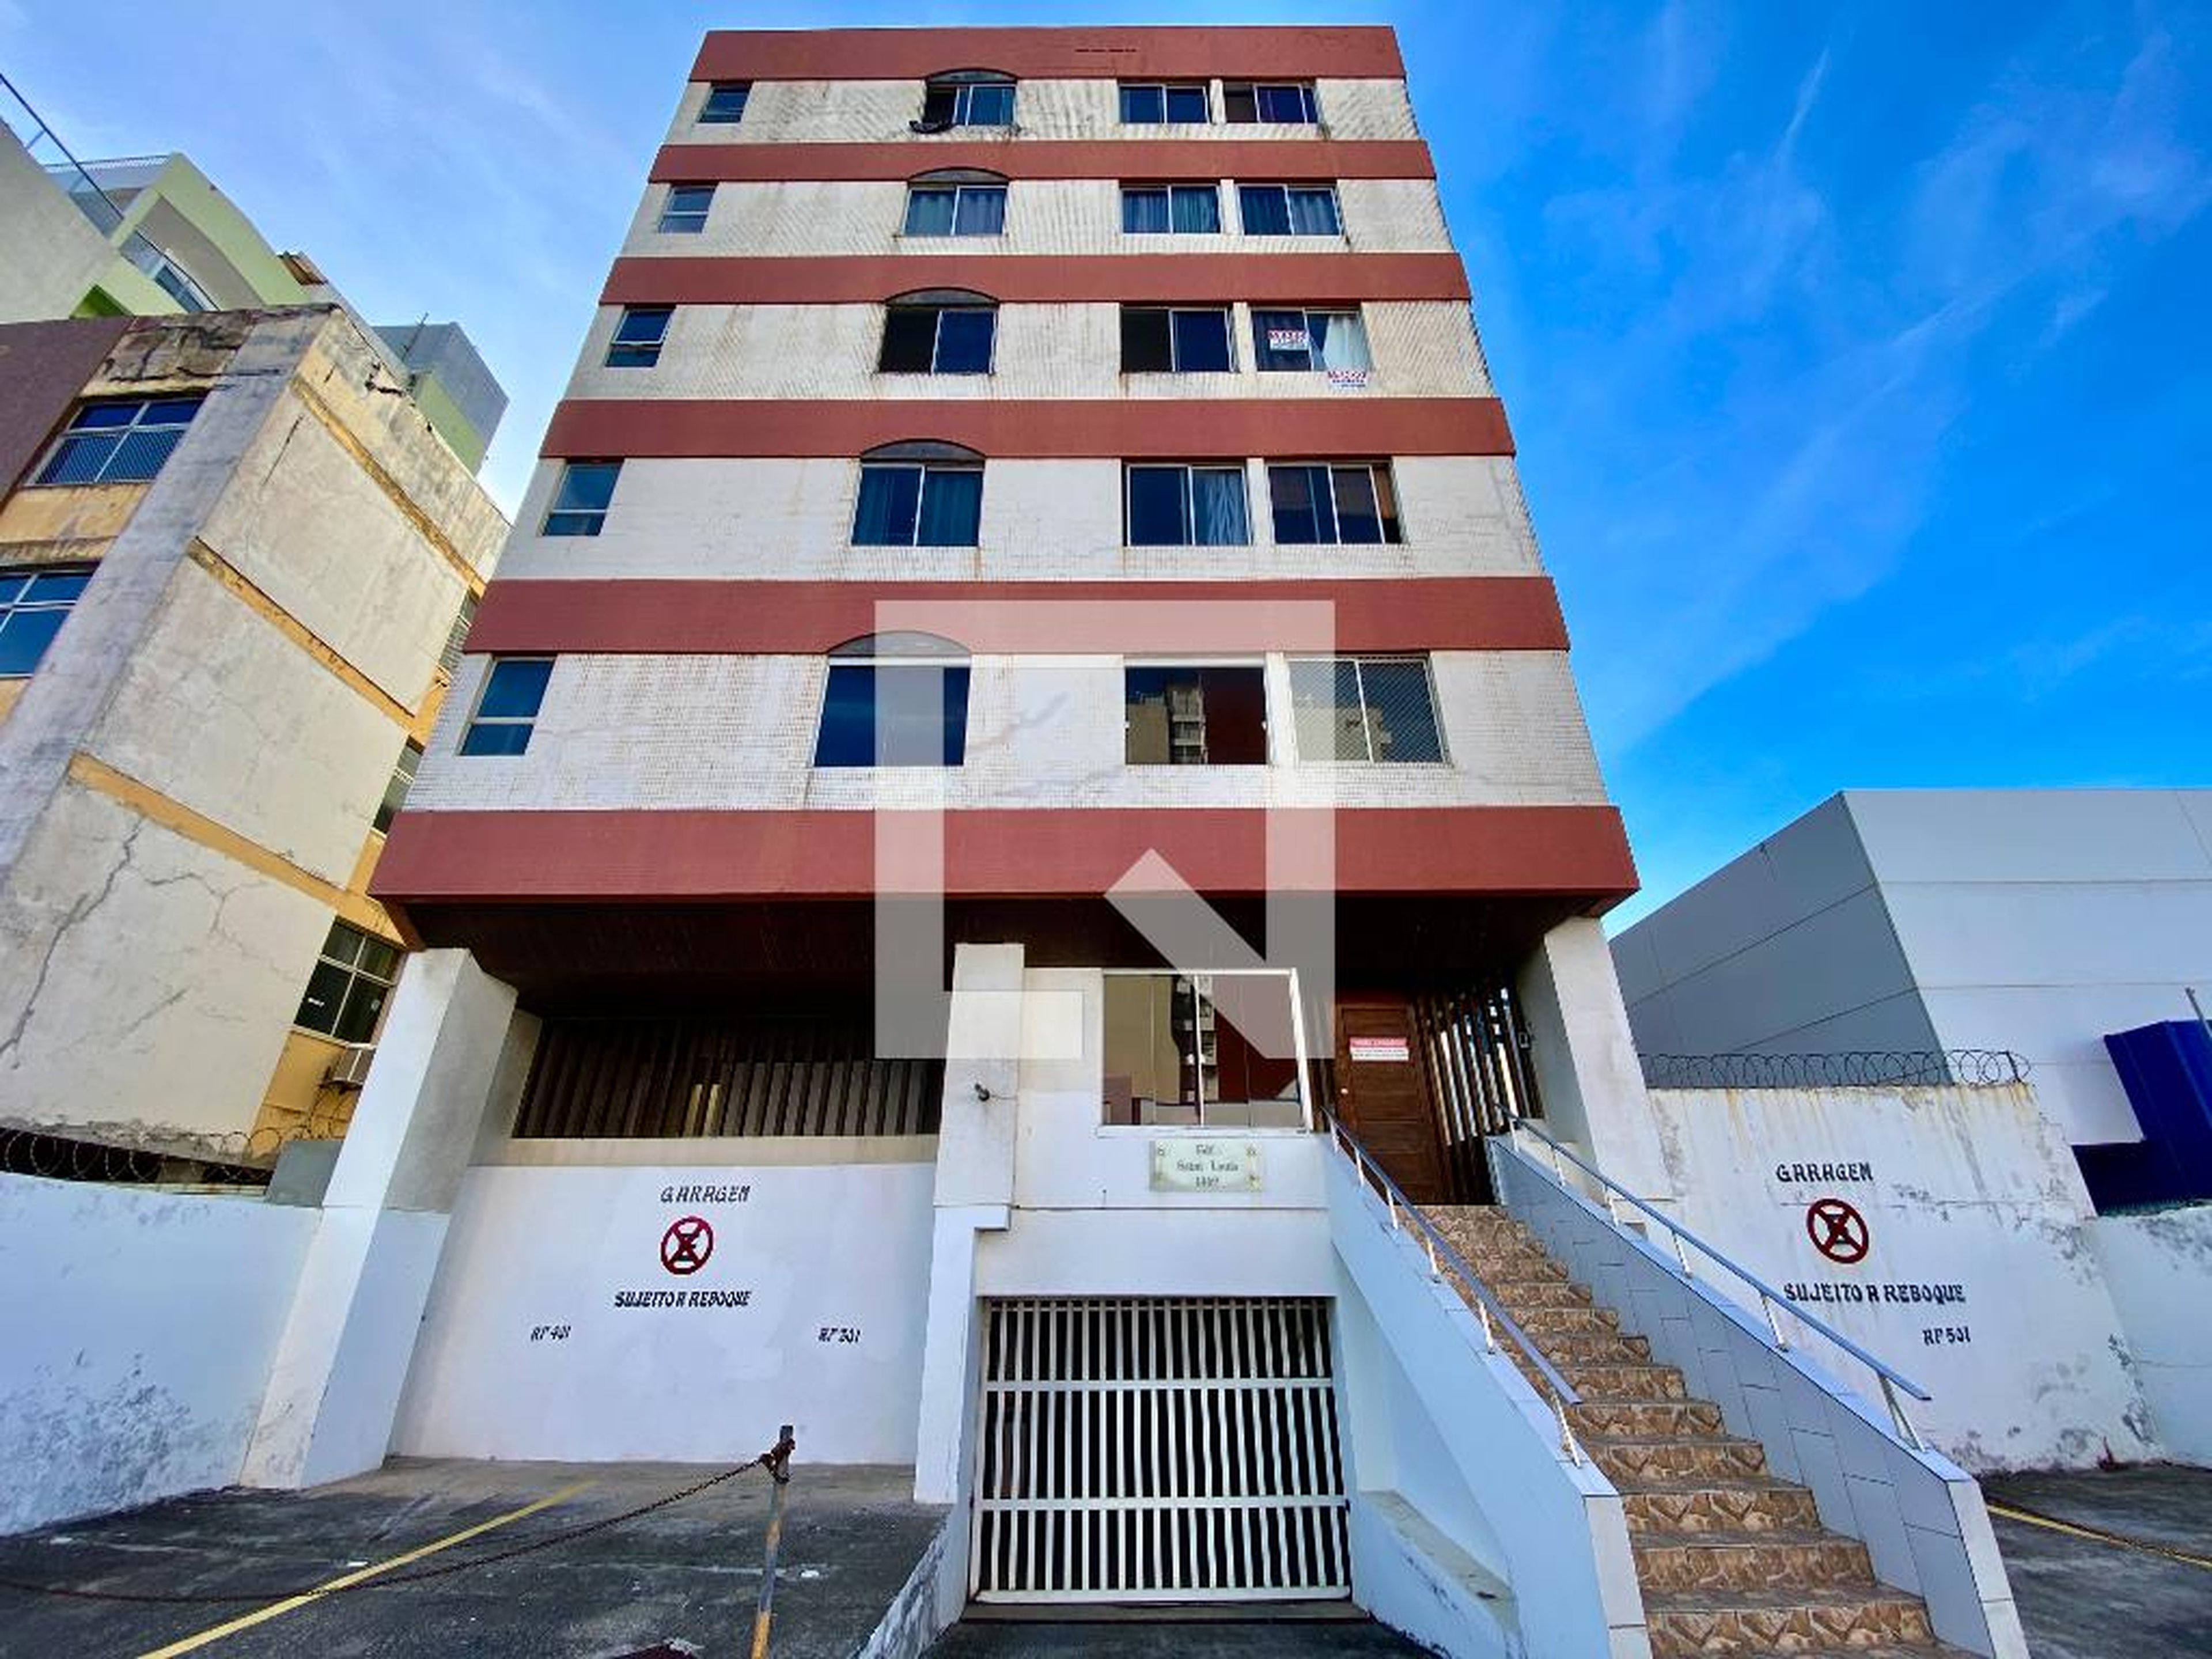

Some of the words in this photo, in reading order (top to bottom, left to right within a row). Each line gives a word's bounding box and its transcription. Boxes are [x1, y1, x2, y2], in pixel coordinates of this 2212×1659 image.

[1775, 1161, 1873, 1182] GARAGEM
[660, 1185, 751, 1203] GARAGEM
[1783, 1282, 1863, 1302] SUJEITO
[1866, 1284, 1880, 1303] A
[1883, 1283, 1966, 1304] REBOQUE
